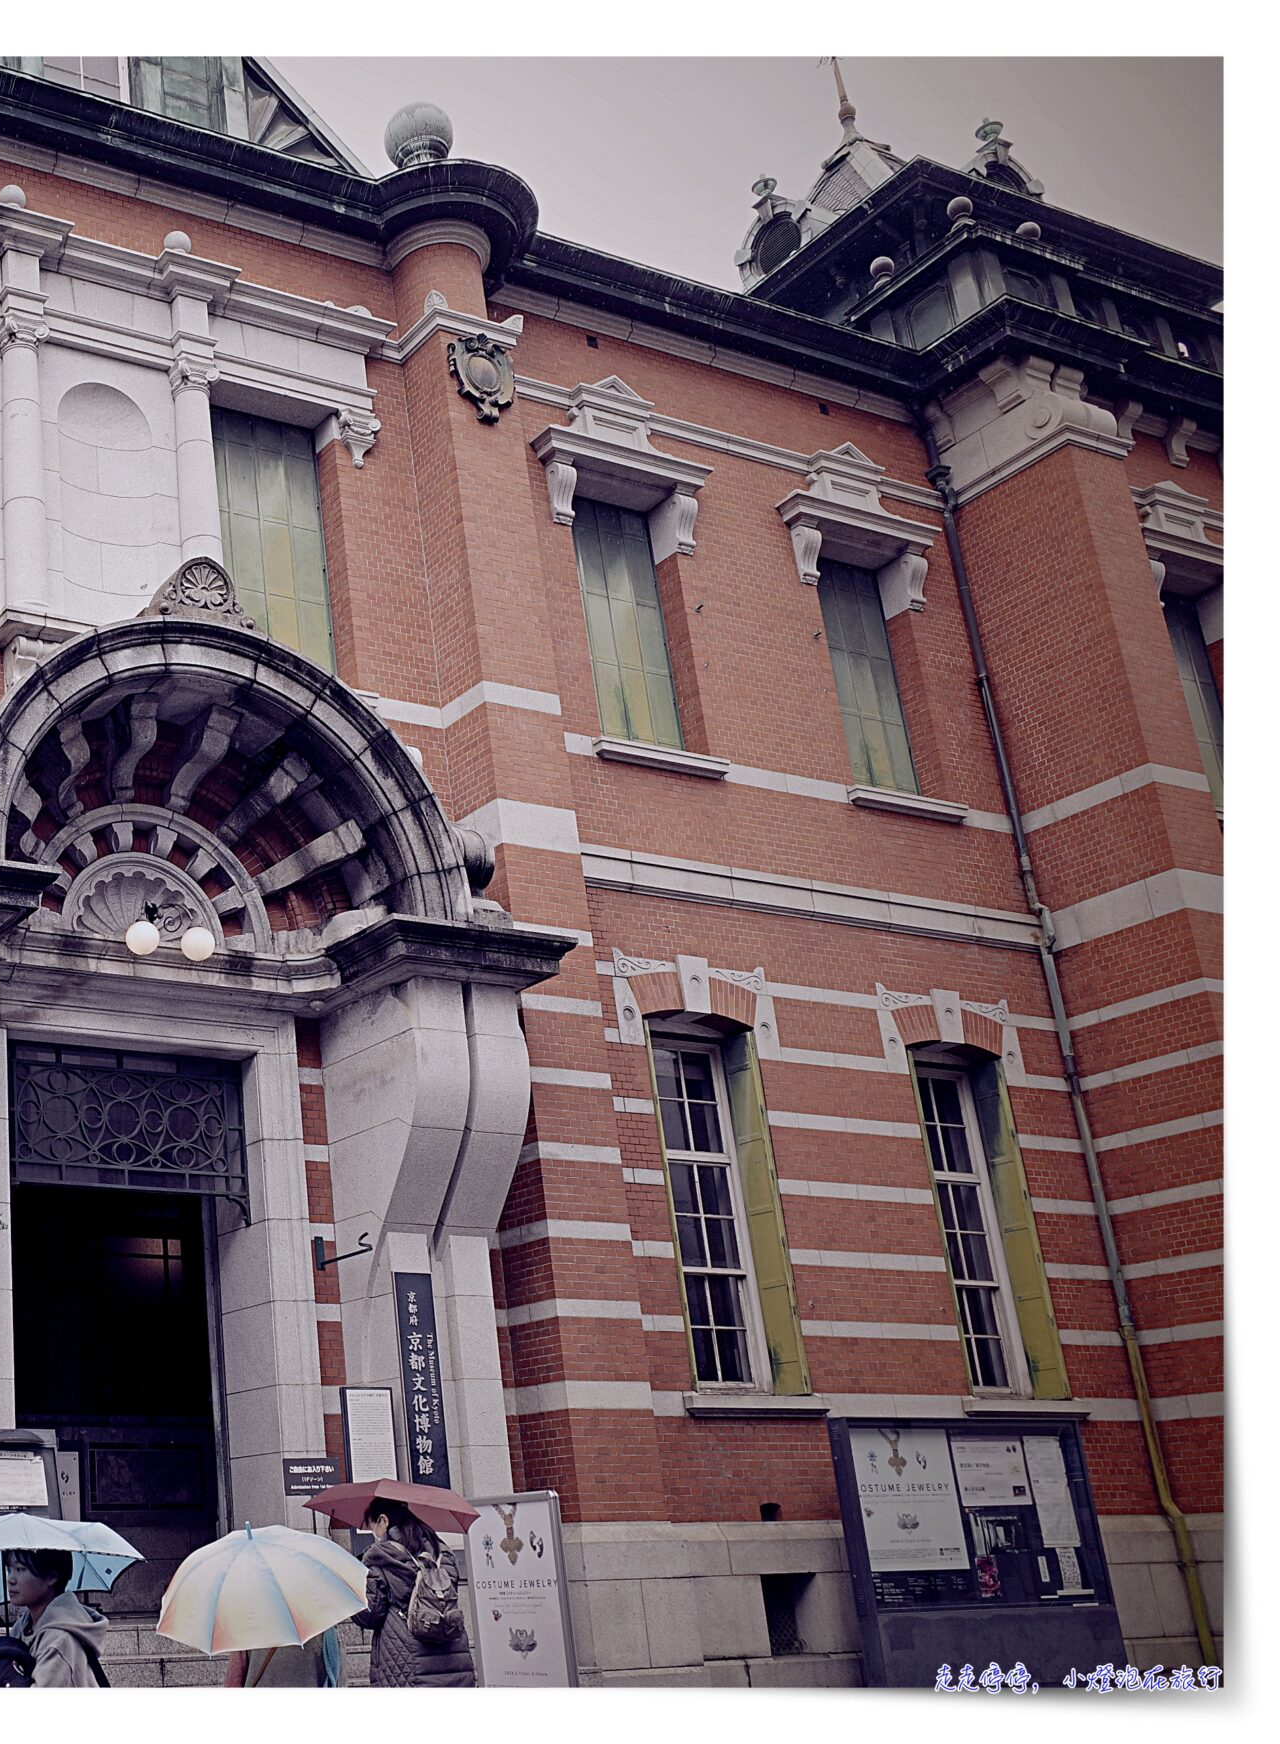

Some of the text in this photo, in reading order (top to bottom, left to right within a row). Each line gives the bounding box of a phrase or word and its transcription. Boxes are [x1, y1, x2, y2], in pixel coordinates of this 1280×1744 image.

[428, 1350, 436, 1387] Museum
[406, 1290, 435, 1476] 京都府 京都文化博物館
[431, 1388, 439, 1398] of
[431, 1399, 440, 1425] Kyoto
[860, 1482, 949, 1493] OSTUME JEWELRY
[475, 1578, 558, 1590] COSTUME JEWELRY
